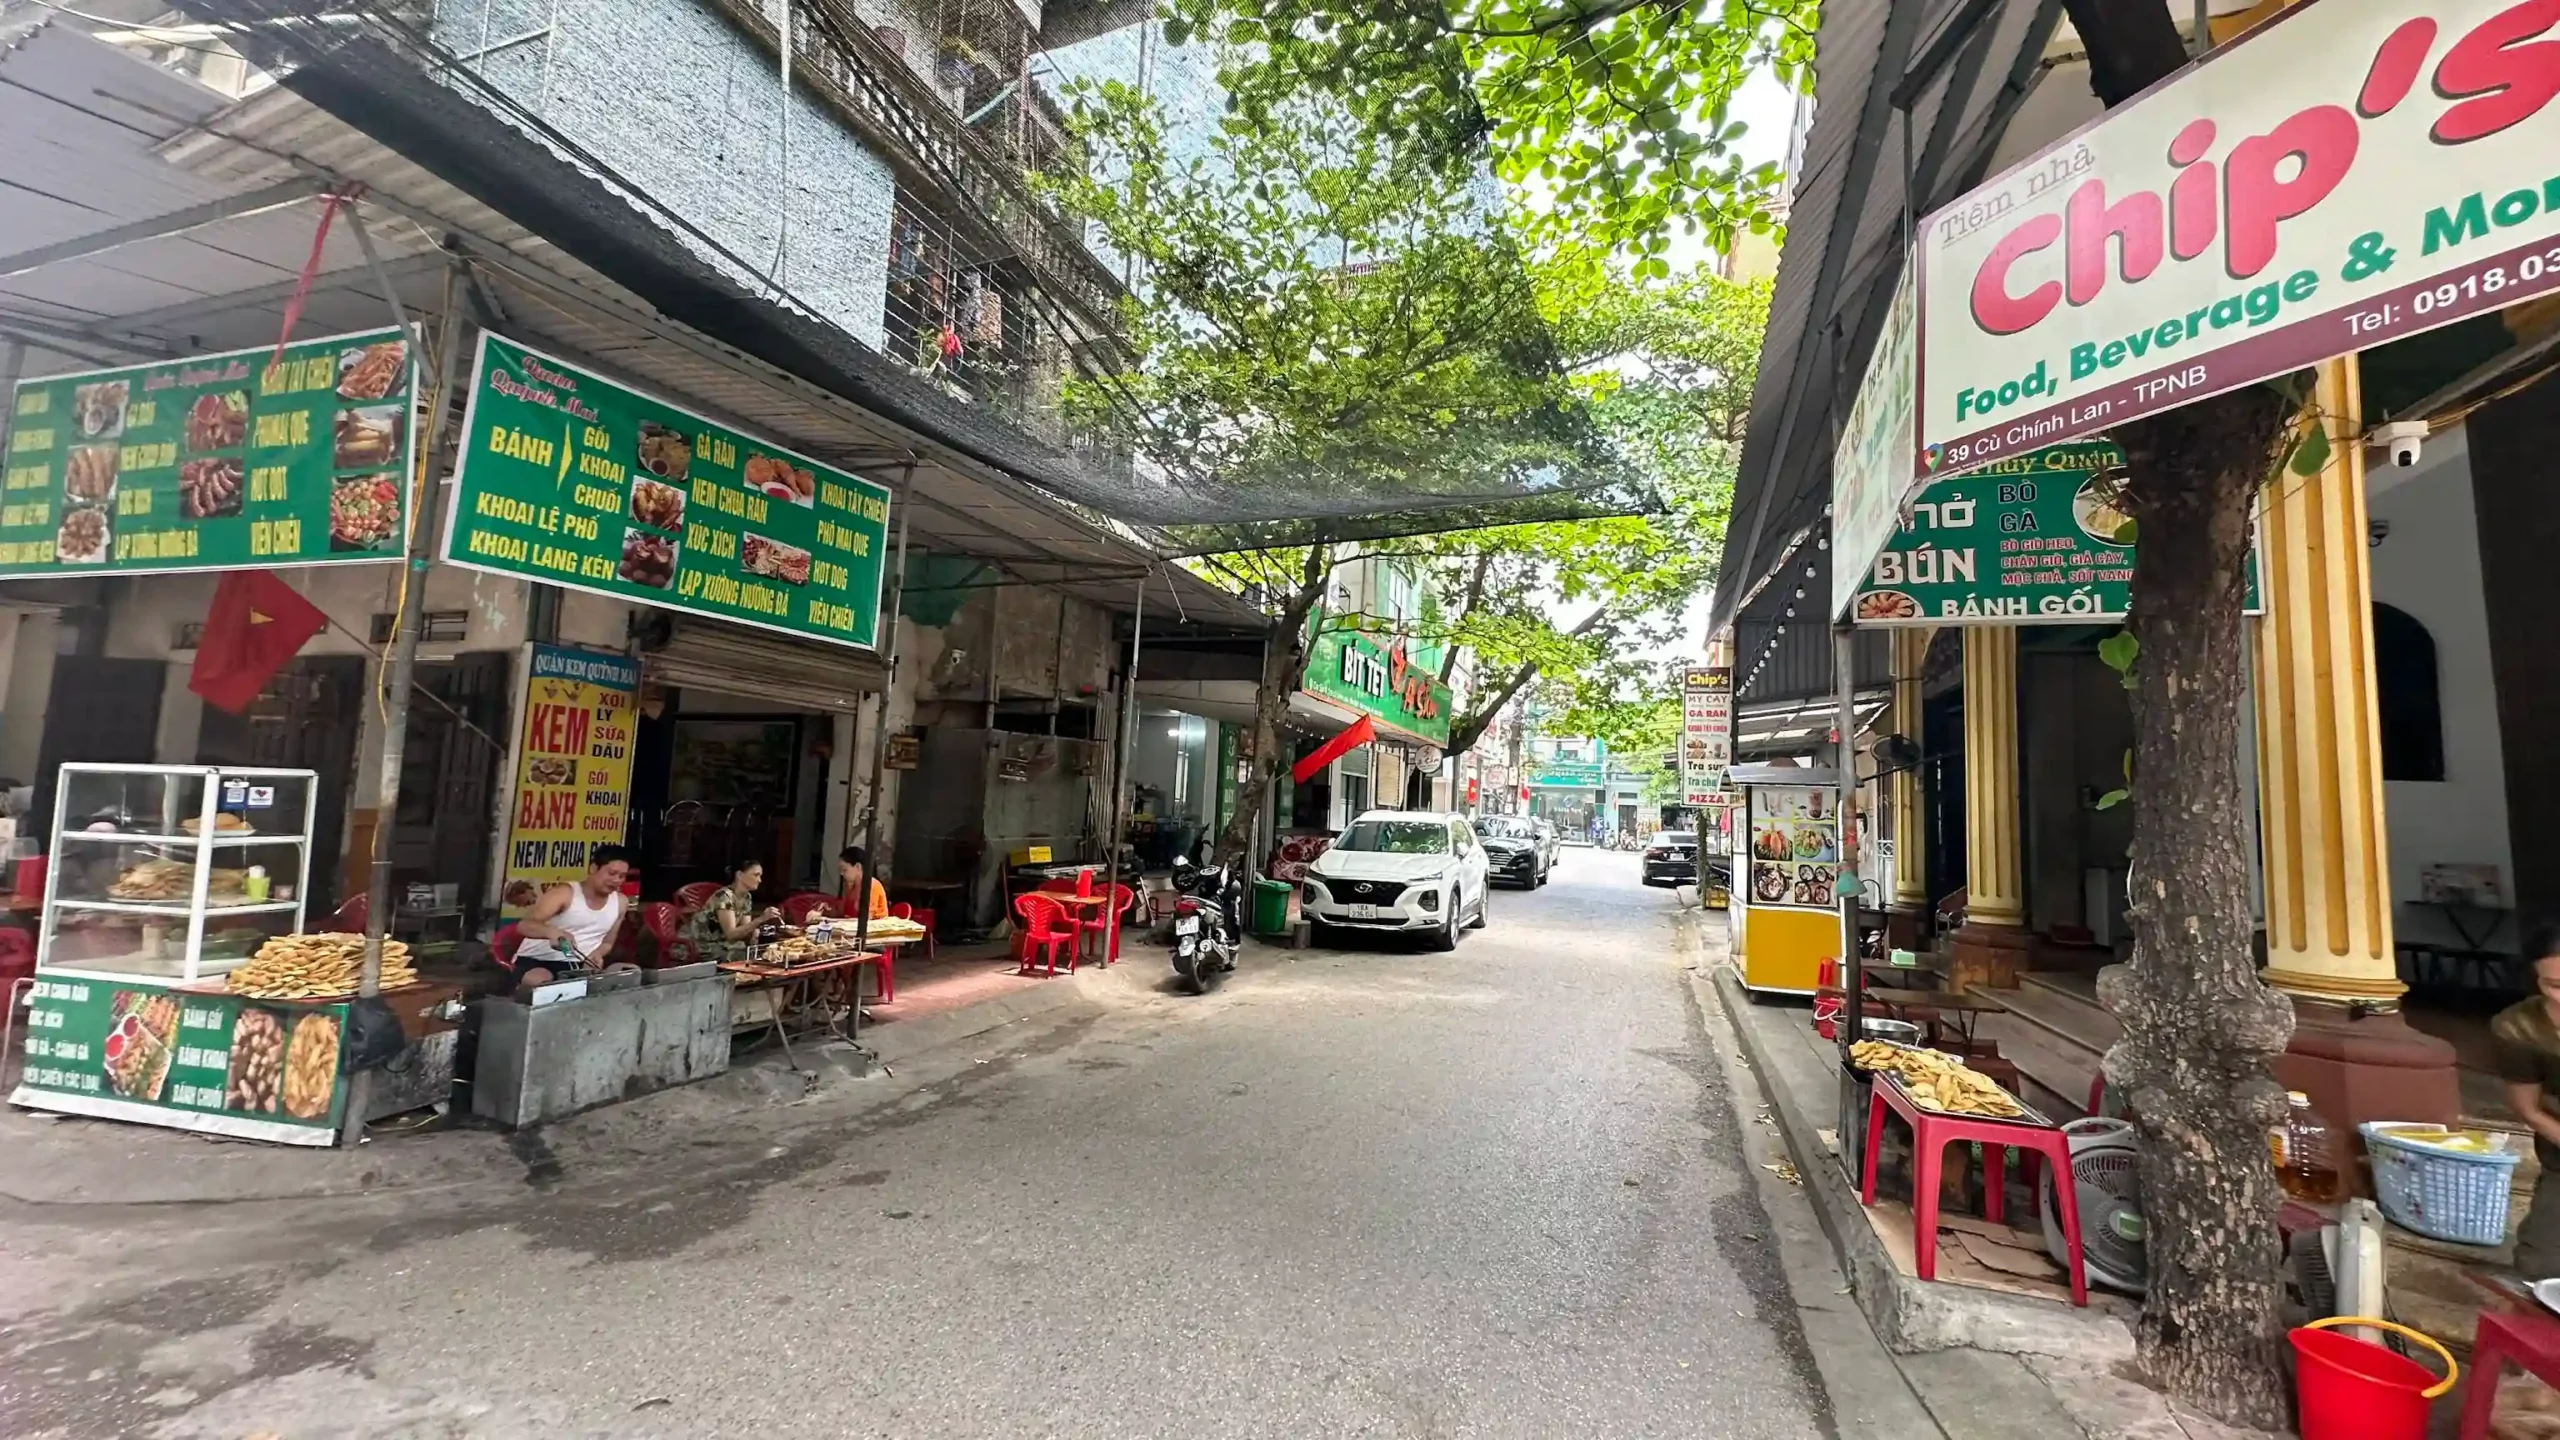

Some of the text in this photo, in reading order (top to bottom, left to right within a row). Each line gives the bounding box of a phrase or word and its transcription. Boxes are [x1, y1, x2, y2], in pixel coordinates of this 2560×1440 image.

[1969, 0, 2560, 336] Chip's
[1940, 144, 2095, 243] Tiệm nhà
[1956, 359, 2059, 423] Food,
[2069, 269, 2319, 382] Beverage
[2341, 230, 2398, 282] &
[2344, 298, 2401, 336] Tel:
[1948, 445, 1970, 465] 39
[1974, 432, 2000, 456] Cù
[2006, 414, 2064, 444] Chính
[2070, 401, 2111, 426] Lan
[2133, 365, 2207, 403] TPNB
[490, 426, 553, 467] BÁNH
[583, 425, 610, 452] GỐI
[713, 437, 736, 470] RÁN
[579, 452, 625, 484] KHOAI
[574, 483, 621, 514] CHUỐI
[691, 477, 717, 503] NEM
[719, 486, 745, 518] CHUA
[821, 480, 846, 511] KHOAI
[1998, 479, 2037, 503] BÒ
[476, 492, 533, 526] KHOAI
[564, 514, 600, 541] PHỐ
[1908, 492, 1976, 531] hở
[2000, 508, 2038, 533] GÀ
[469, 529, 615, 581] KHOAI LANG KÉN
[685, 520, 736, 560] XÚC XÍCH
[853, 532, 869, 557] QUE
[813, 560, 848, 591] HOT DOG
[1873, 542, 1976, 585] BÚN
[677, 567, 701, 601] LẠP
[1941, 592, 2027, 617] BÁNH
[2039, 585, 2102, 615] GỐI
[565, 659, 587, 677] KEM
[1687, 673, 1728, 687] Chip's
[597, 708, 613, 721] LY
[1706, 695, 1728, 703] CAY
[528, 702, 590, 756] KEM
[517, 783, 577, 830] BÁNH
[585, 790, 621, 806] KHOAI
[1688, 794, 1725, 804] PIZZA
[514, 840, 547, 869] NEM
[550, 840, 585, 868] CHUA
